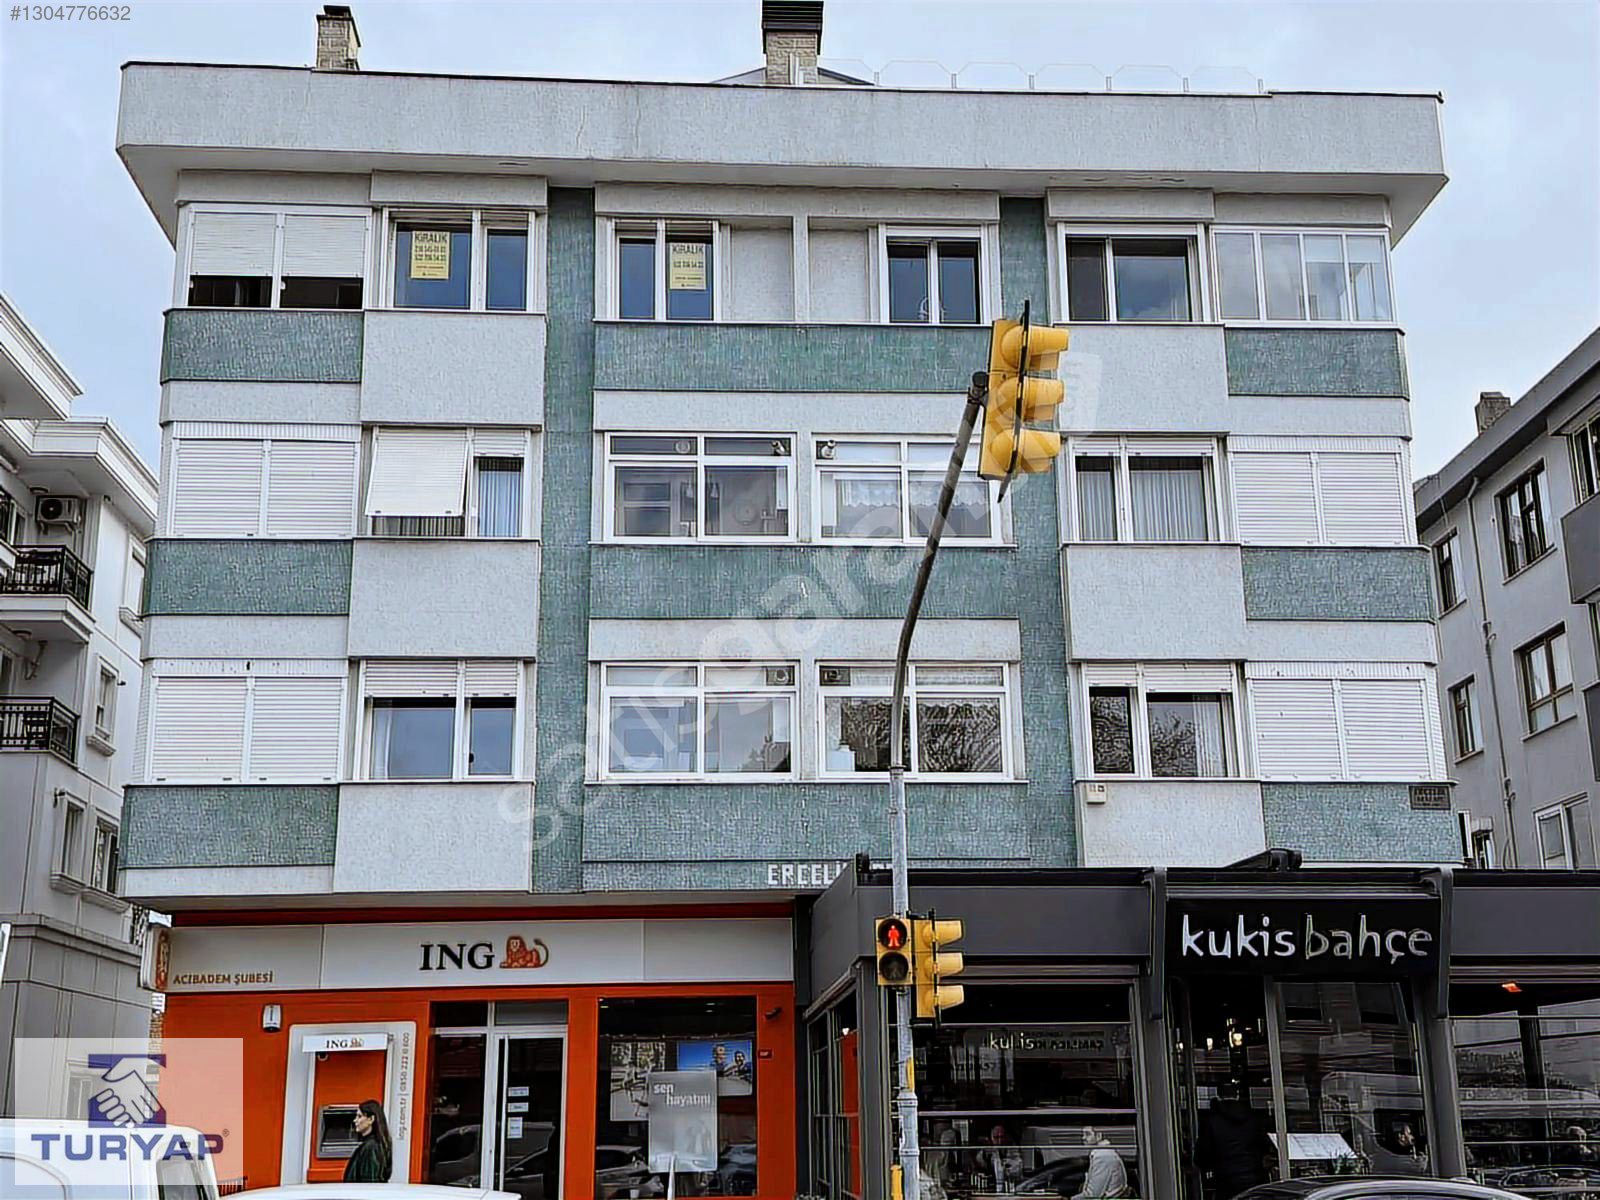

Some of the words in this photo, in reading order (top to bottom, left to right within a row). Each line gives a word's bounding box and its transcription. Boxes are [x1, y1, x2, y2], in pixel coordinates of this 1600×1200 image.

[1182, 914, 1296, 959] kukis
[1305, 913, 1433, 965] bahçe
[419, 941, 495, 970] ING
[173, 974, 231, 985] ACIBADEM
[234, 970, 273, 985] ŞUBESİ
[326, 1039, 348, 1049] ING
[653, 1083, 674, 1094] sen
